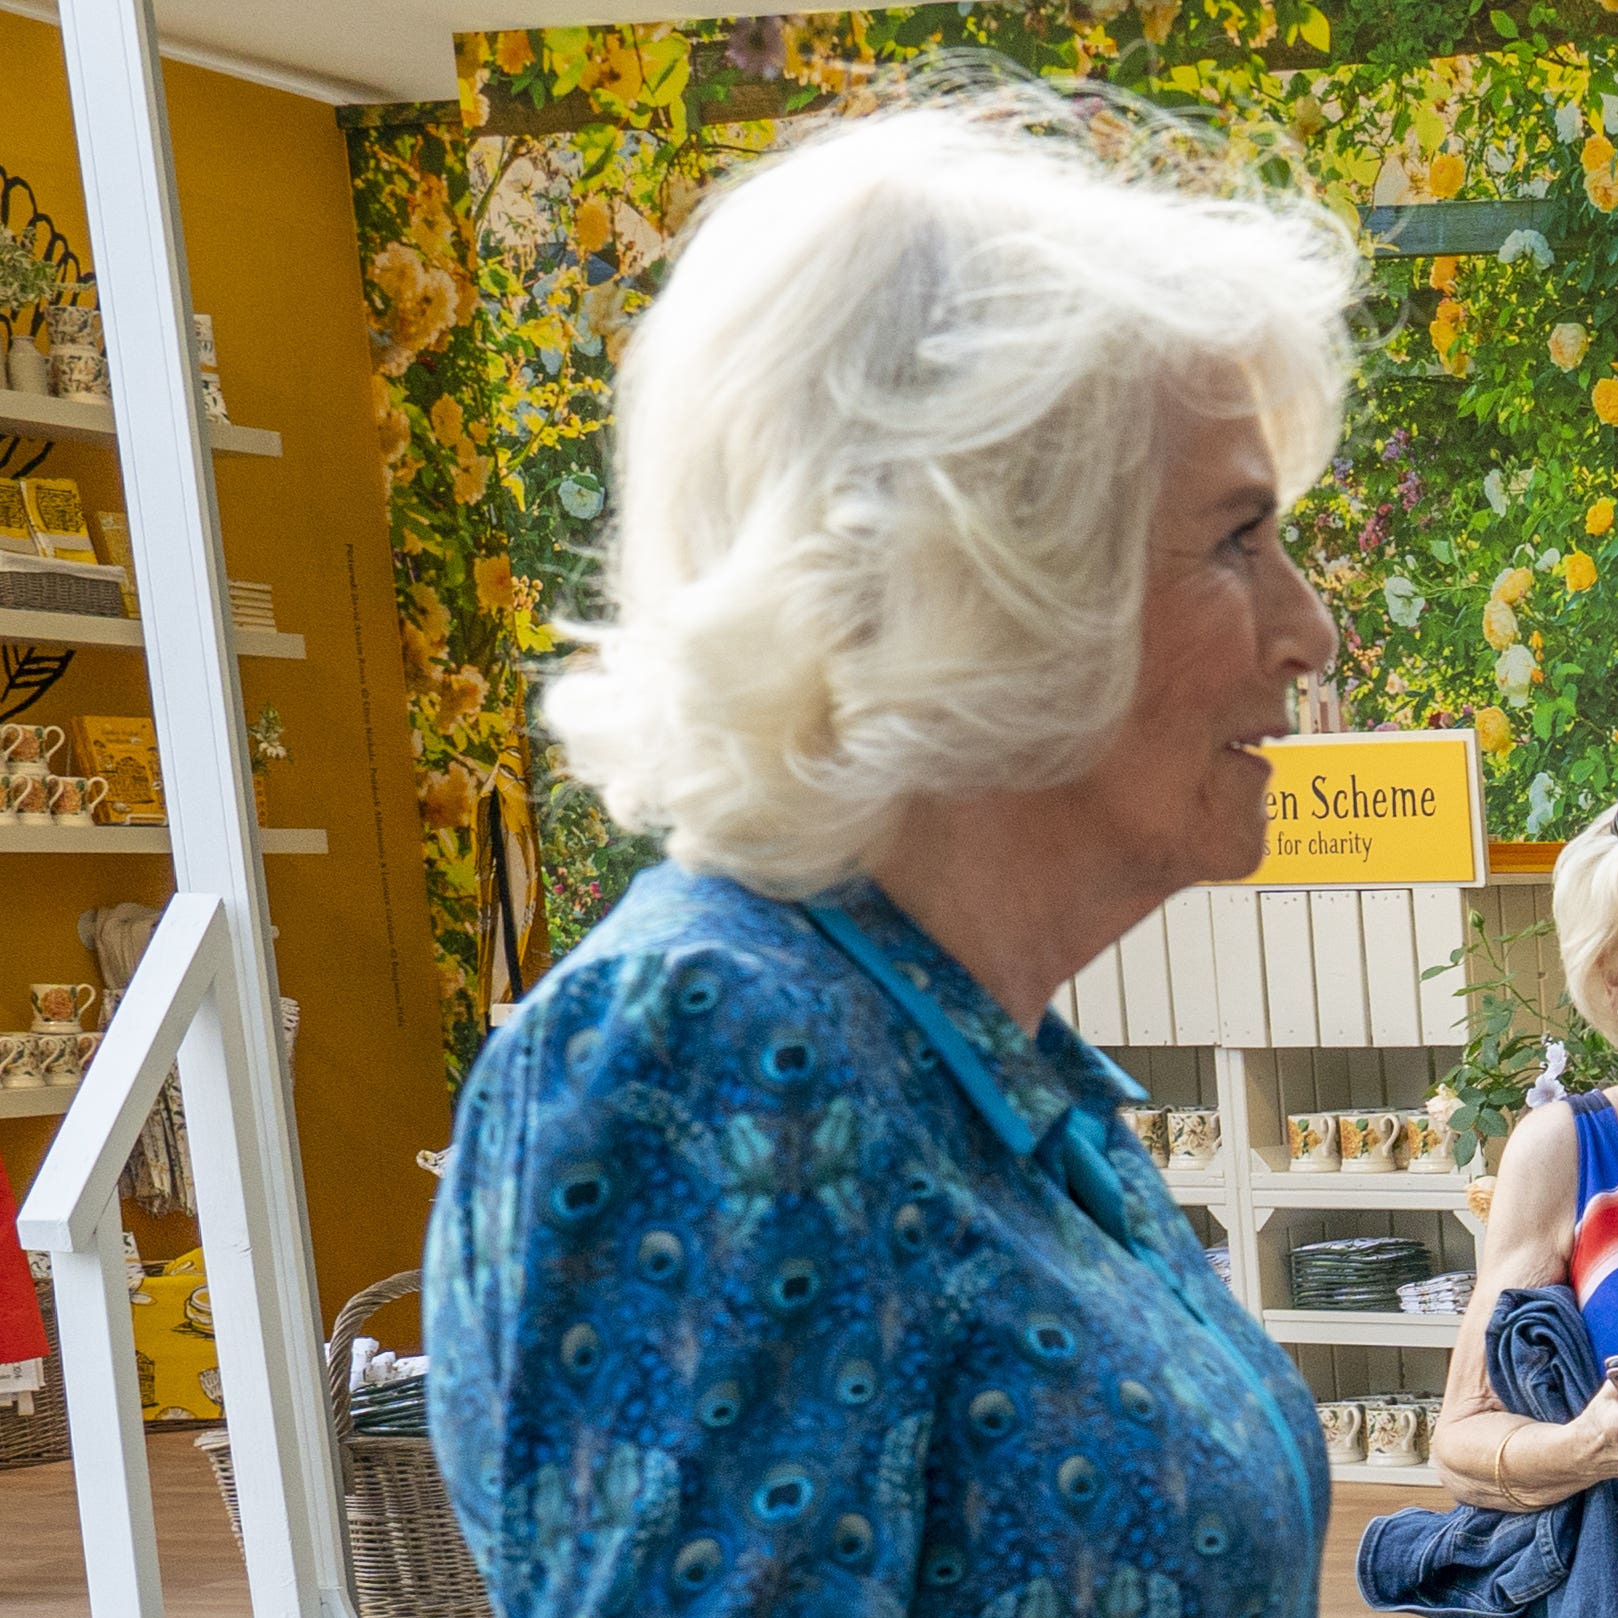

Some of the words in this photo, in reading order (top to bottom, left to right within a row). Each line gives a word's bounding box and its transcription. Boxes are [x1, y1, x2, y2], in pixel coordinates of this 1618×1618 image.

[1265, 790, 1298, 820] en
[1311, 774, 1437, 820] Scheme
[1277, 832, 1302, 855] for
[1308, 831, 1373, 863] charity
